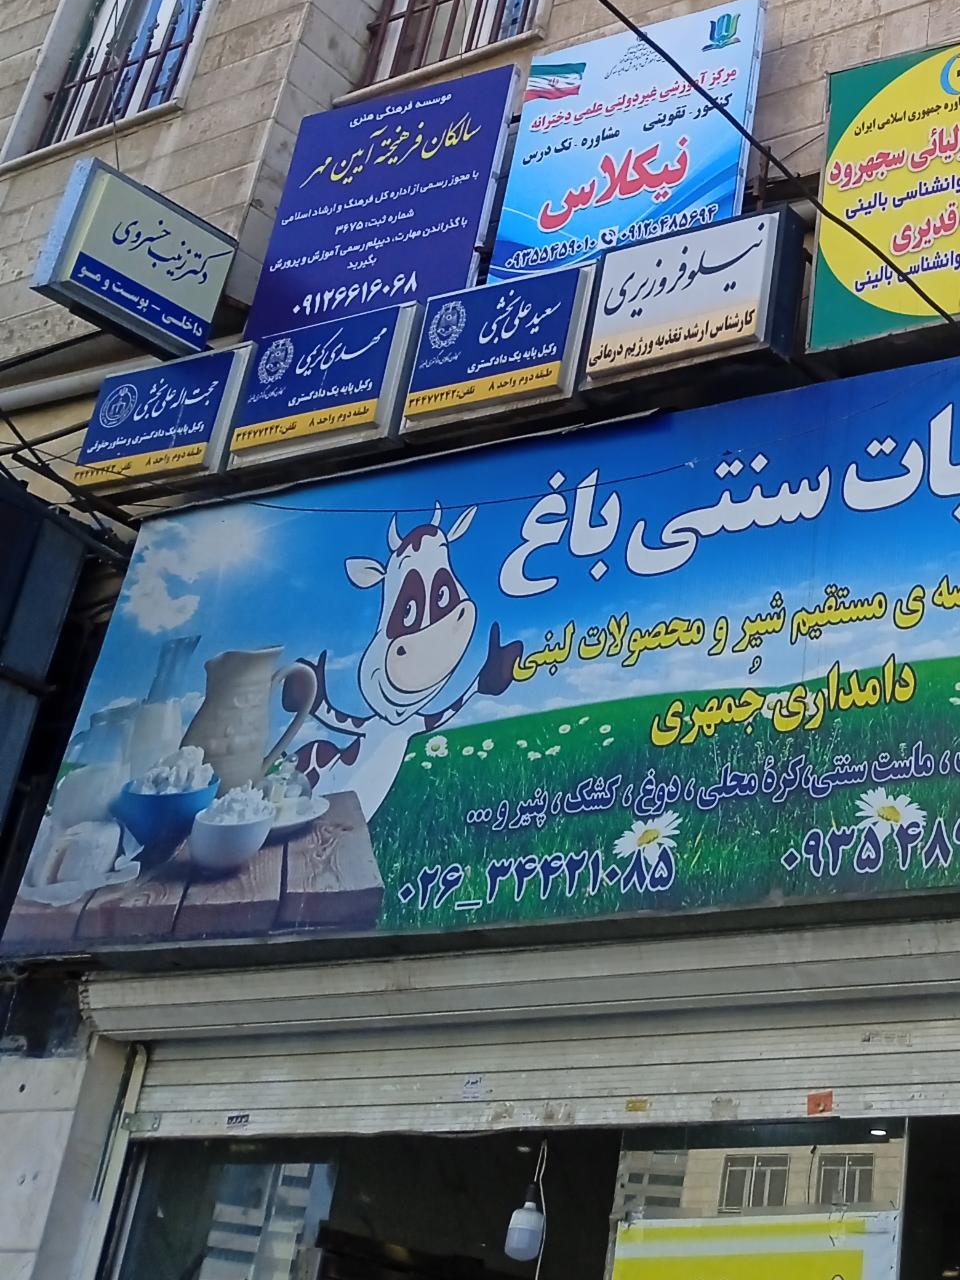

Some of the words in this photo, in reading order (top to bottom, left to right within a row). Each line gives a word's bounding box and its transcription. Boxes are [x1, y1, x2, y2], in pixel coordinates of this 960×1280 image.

[658, 70, 708, 100] آوزشی
[708, 67, 737, 88] مرکز
[375, 100, 413, 121] فرهنگی
[414, 93, 453, 109] موسسه
[348, 112, 375, 128] هنری
[530, 111, 572, 132] دخترانه
[573, 101, 603, 123] علمی
[642, 104, 688, 132] تقویتی
[877, 109, 907, 130] اسلامی
[907, 102, 942, 122] جمهوری
[580, 126, 621, 149] مشاوره
[853, 118, 876, 136] ایران
[521, 145, 552, 166] درس
[553, 137, 573, 154] تک
[298, 156, 333, 189] مهر
[471, 169, 480, 181] با
[829, 148, 905, 189] سجهرود
[419, 178, 449, 194] رسمی
[448, 173, 471, 187] مجوز
[538, 135, 690, 233] نیکلاس
[343, 194, 375, 210] فرهنگ
[374, 190, 389, 204] کل
[390, 185, 410, 201] اداره
[311, 202, 337, 218] ارشاد
[387, 207, 416, 224] شماره
[845, 192, 888, 219] بالینی
[280, 209, 312, 226] اسلامی
[421, 215, 461, 237] گذراندن
[460, 215, 468, 228] با
[891, 201, 957, 253] قدیری
[111, 219, 172, 252] خسروی
[364, 236, 391, 252] دیپلم
[309, 245, 341, 264] آموزش
[339, 242, 366, 256] رسمی
[667, 221, 766, 294] نیلوفر
[170, 249, 234, 285] دکتر
[268, 257, 302, 273] پرورش
[346, 254, 378, 271] بگیرید
[77, 265, 102, 283] مو
[853, 264, 894, 292] بالینی
[111, 280, 150, 313] پوست
[291, 270, 418, 317] ۰۹۱۲۶۶۱۶۰۶۸
[602, 258, 668, 318] وزیری
[161, 311, 204, 338] داخلی
[524, 300, 562, 335] سعید
[709, 307, 756, 339] کارشناس
[654, 326, 682, 351] تغذیه
[683, 319, 709, 343] ارشد
[295, 327, 345, 377] کریمی
[319, 327, 389, 371] مهدی
[522, 345, 538, 361] پایه
[536, 342, 558, 359] وکیل
[588, 340, 624, 368] درمانی
[624, 334, 648, 359] رژیم
[466, 354, 508, 374] دادگستری
[534, 367, 553, 381] طبقه
[339, 381, 354, 397] پایه
[352, 377, 374, 394] وکیل
[488, 381, 495, 391] ۸
[496, 378, 517, 391] واحد
[518, 374, 535, 387] دوم
[183, 378, 220, 407] حجت
[287, 388, 327, 408] دادگستری
[316, 414, 335, 427] واحد
[336, 410, 353, 424] دوم
[351, 404, 370, 418] طبقه
[131, 429, 166, 446] دادگستری
[187, 420, 206, 434] وکیل
[86, 441, 110, 455] حقوقی
[109, 437, 127, 450] مشاور
[623, 453, 832, 576] سنتی
[498, 467, 623, 598] باغ
[789, 582, 889, 645] مستقیم
[893, 583, 927, 630] ی
[731, 590, 787, 653] شیر
[577, 610, 706, 668] محصولات
[511, 619, 576, 683] لبنی
[771, 652, 918, 733] دامداری
[871, 739, 935, 782] ماست
[508, 788, 549, 829] پنیر
[780, 821, 885, 878] ۰۹۳۵
